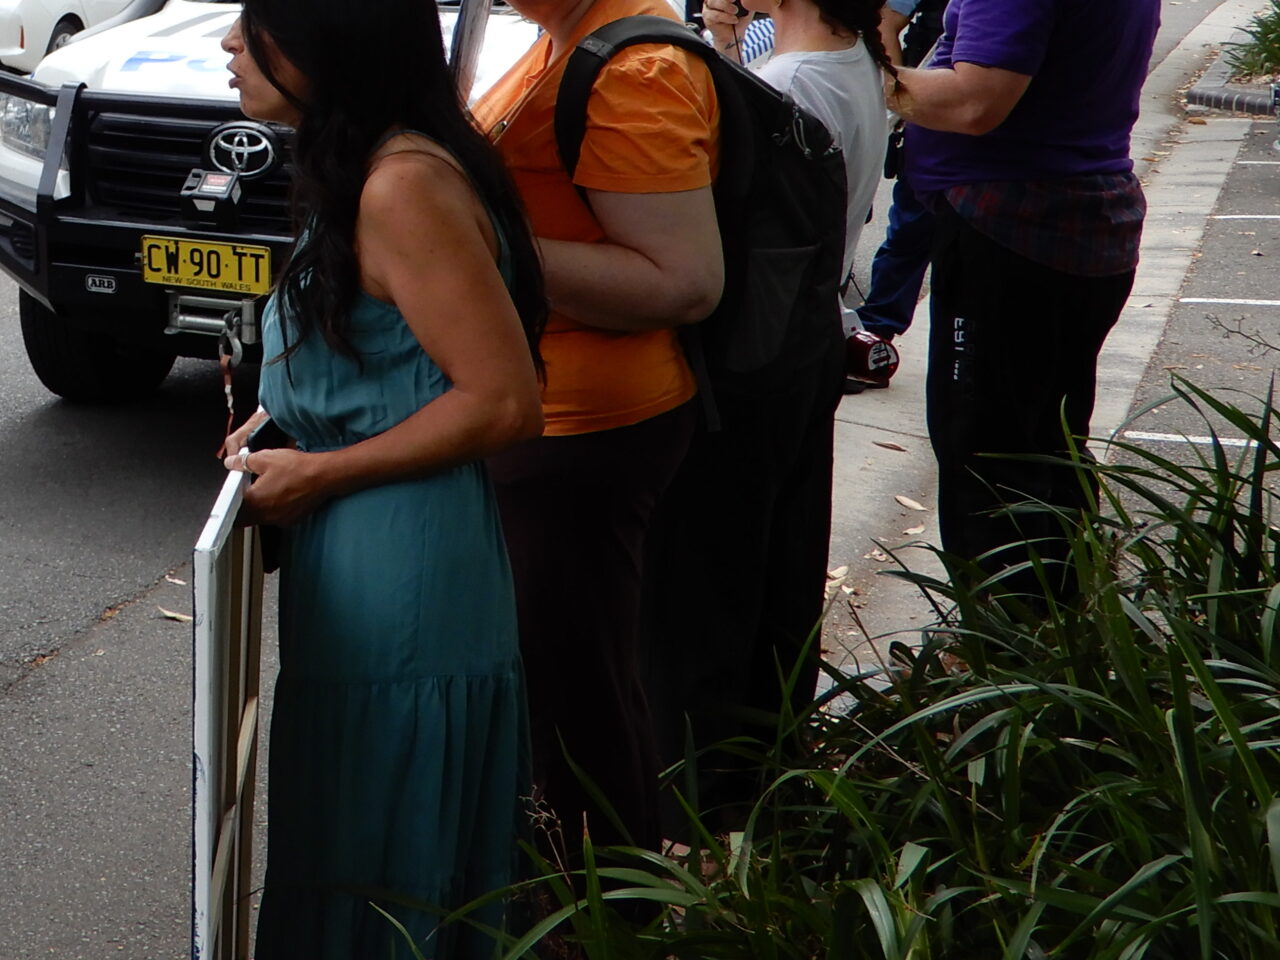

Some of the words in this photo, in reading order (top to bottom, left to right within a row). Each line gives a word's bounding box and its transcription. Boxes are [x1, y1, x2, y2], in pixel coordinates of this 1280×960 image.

[89, 277, 115, 290] ARB
[161, 275, 183, 285] NEW
[186, 277, 217, 289] SOUTH
[221, 280, 252, 292] WALES
